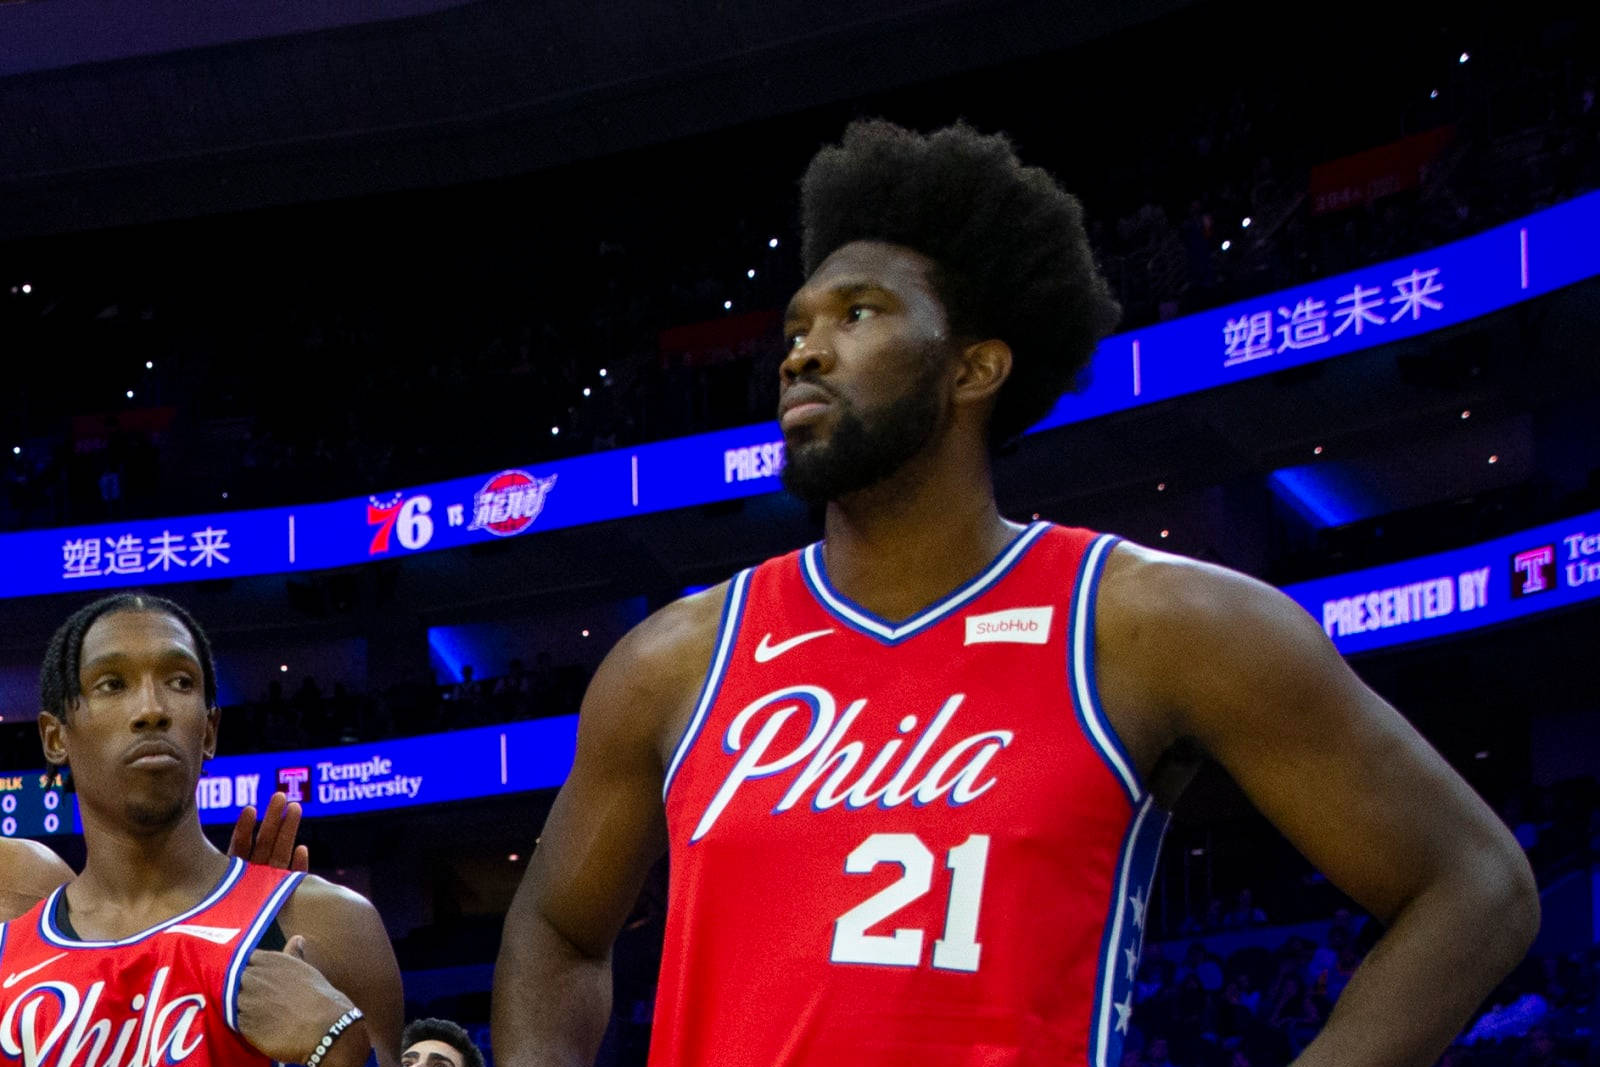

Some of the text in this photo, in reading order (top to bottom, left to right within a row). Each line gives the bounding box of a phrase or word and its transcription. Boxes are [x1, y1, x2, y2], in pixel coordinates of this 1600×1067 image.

[1222, 267, 1445, 369] 塑造未来
[62, 526, 231, 579] 塑造未来
[1322, 566, 1491, 638] PRESENTED BY
[976, 619, 1040, 635] StubHub
[316, 756, 392, 783] Temple
[689, 684, 1014, 846] Phila
[1, 794, 17, 813] 0
[44, 791, 59, 810] 0
[235, 774, 260, 807] BY
[317, 774, 423, 803] University
[2, 813, 59, 836] 0 0
[829, 832, 991, 973] 21
